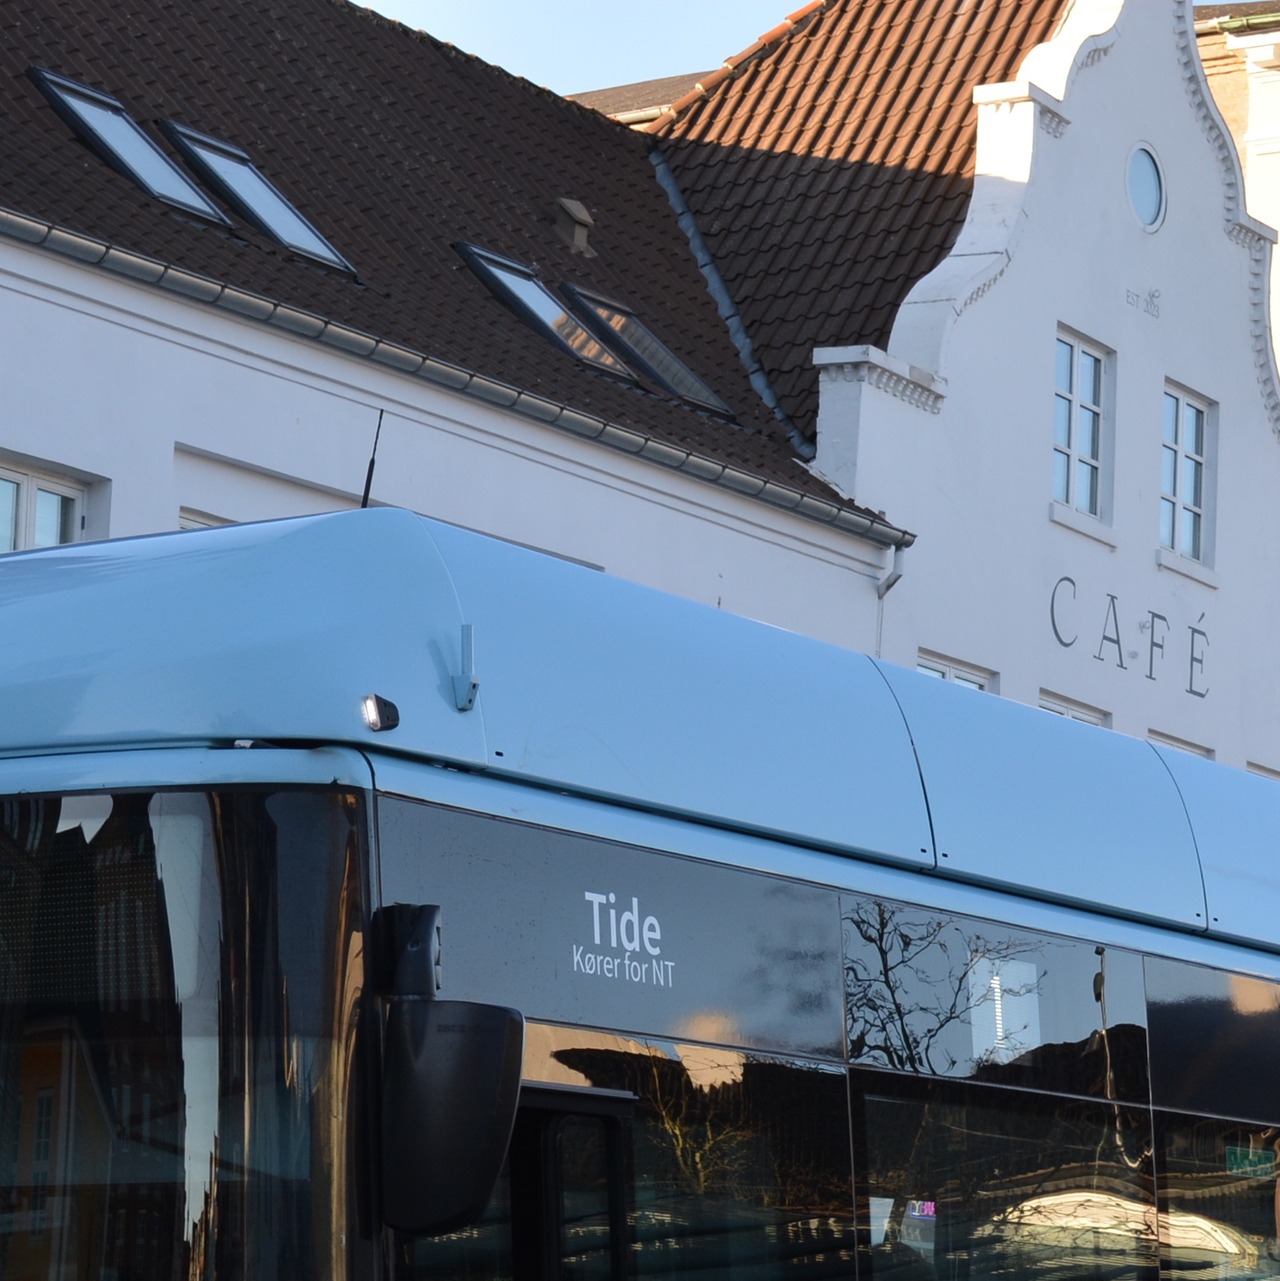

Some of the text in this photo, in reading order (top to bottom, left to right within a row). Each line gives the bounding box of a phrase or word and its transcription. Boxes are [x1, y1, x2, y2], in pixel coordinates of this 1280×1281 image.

[1051, 576, 1210, 699] CAFÉ
[585, 891, 661, 956] Tide
[573, 944, 675, 988] Kører for NT
